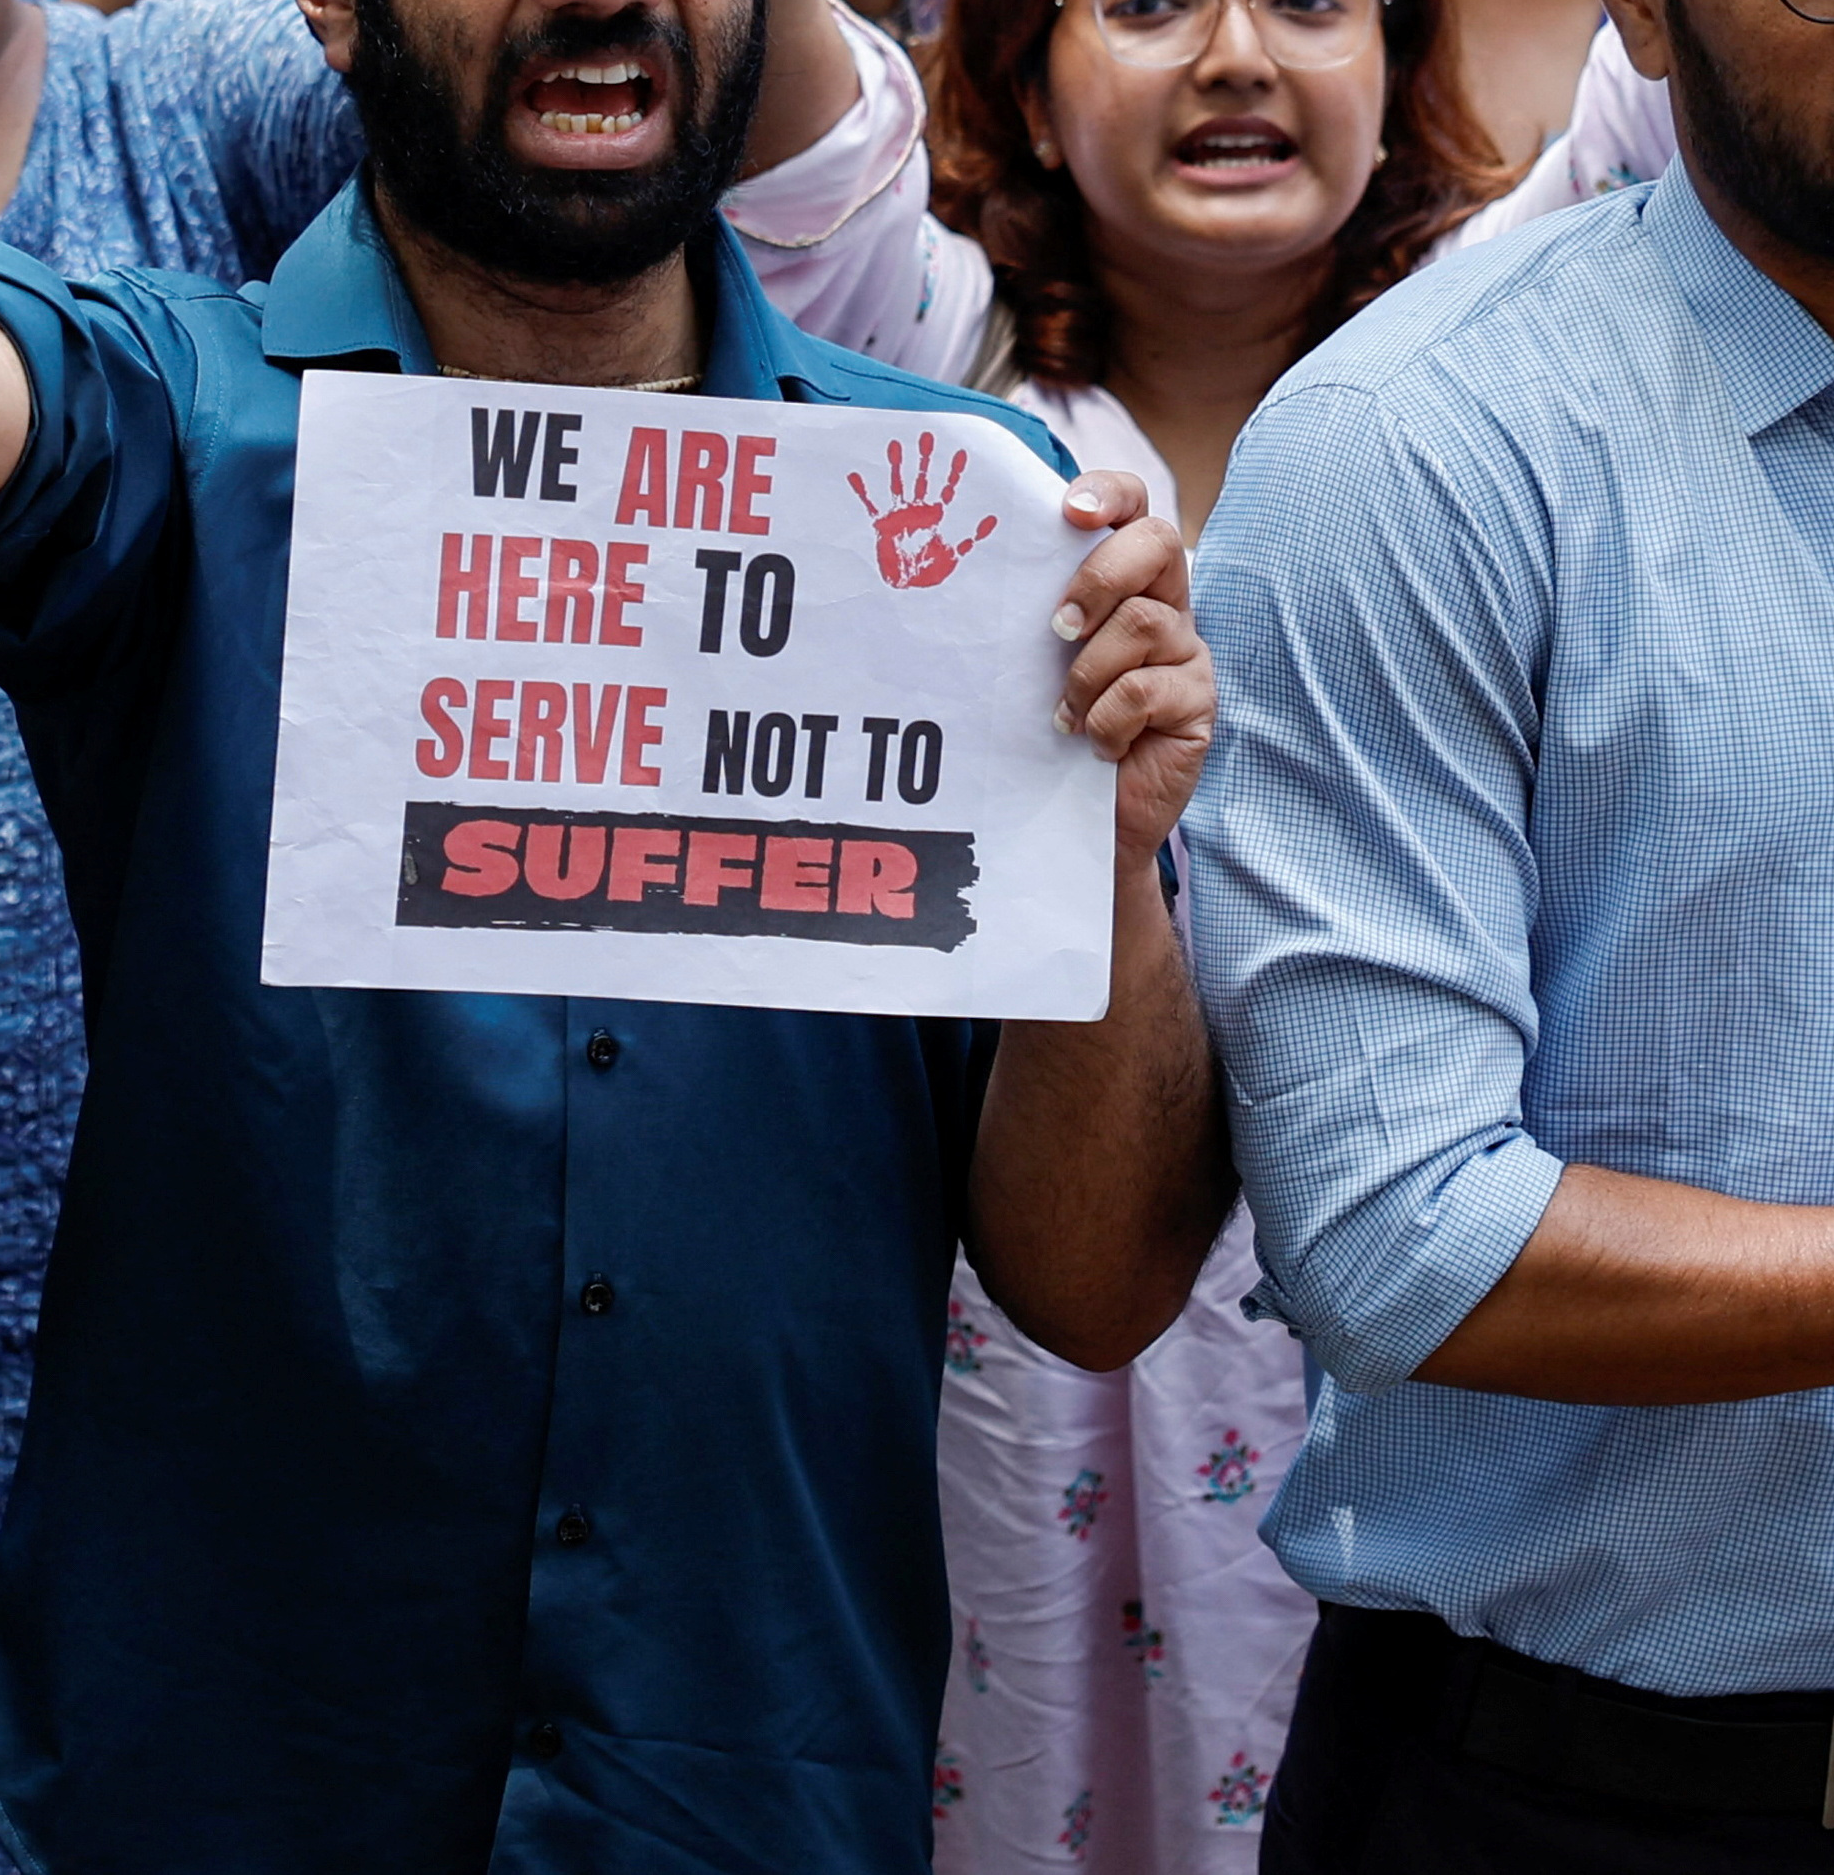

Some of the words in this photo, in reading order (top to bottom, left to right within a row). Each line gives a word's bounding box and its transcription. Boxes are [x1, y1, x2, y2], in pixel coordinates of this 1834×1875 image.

[471, 406, 583, 503] WE
[615, 425, 777, 537] ARE
[435, 532, 650, 647] HERE
[694, 549, 796, 658] TO
[415, 677, 668, 787] SERVE
[702, 710, 838, 800] NOT
[863, 717, 944, 805] TO
[441, 818, 918, 920] SUFFER
